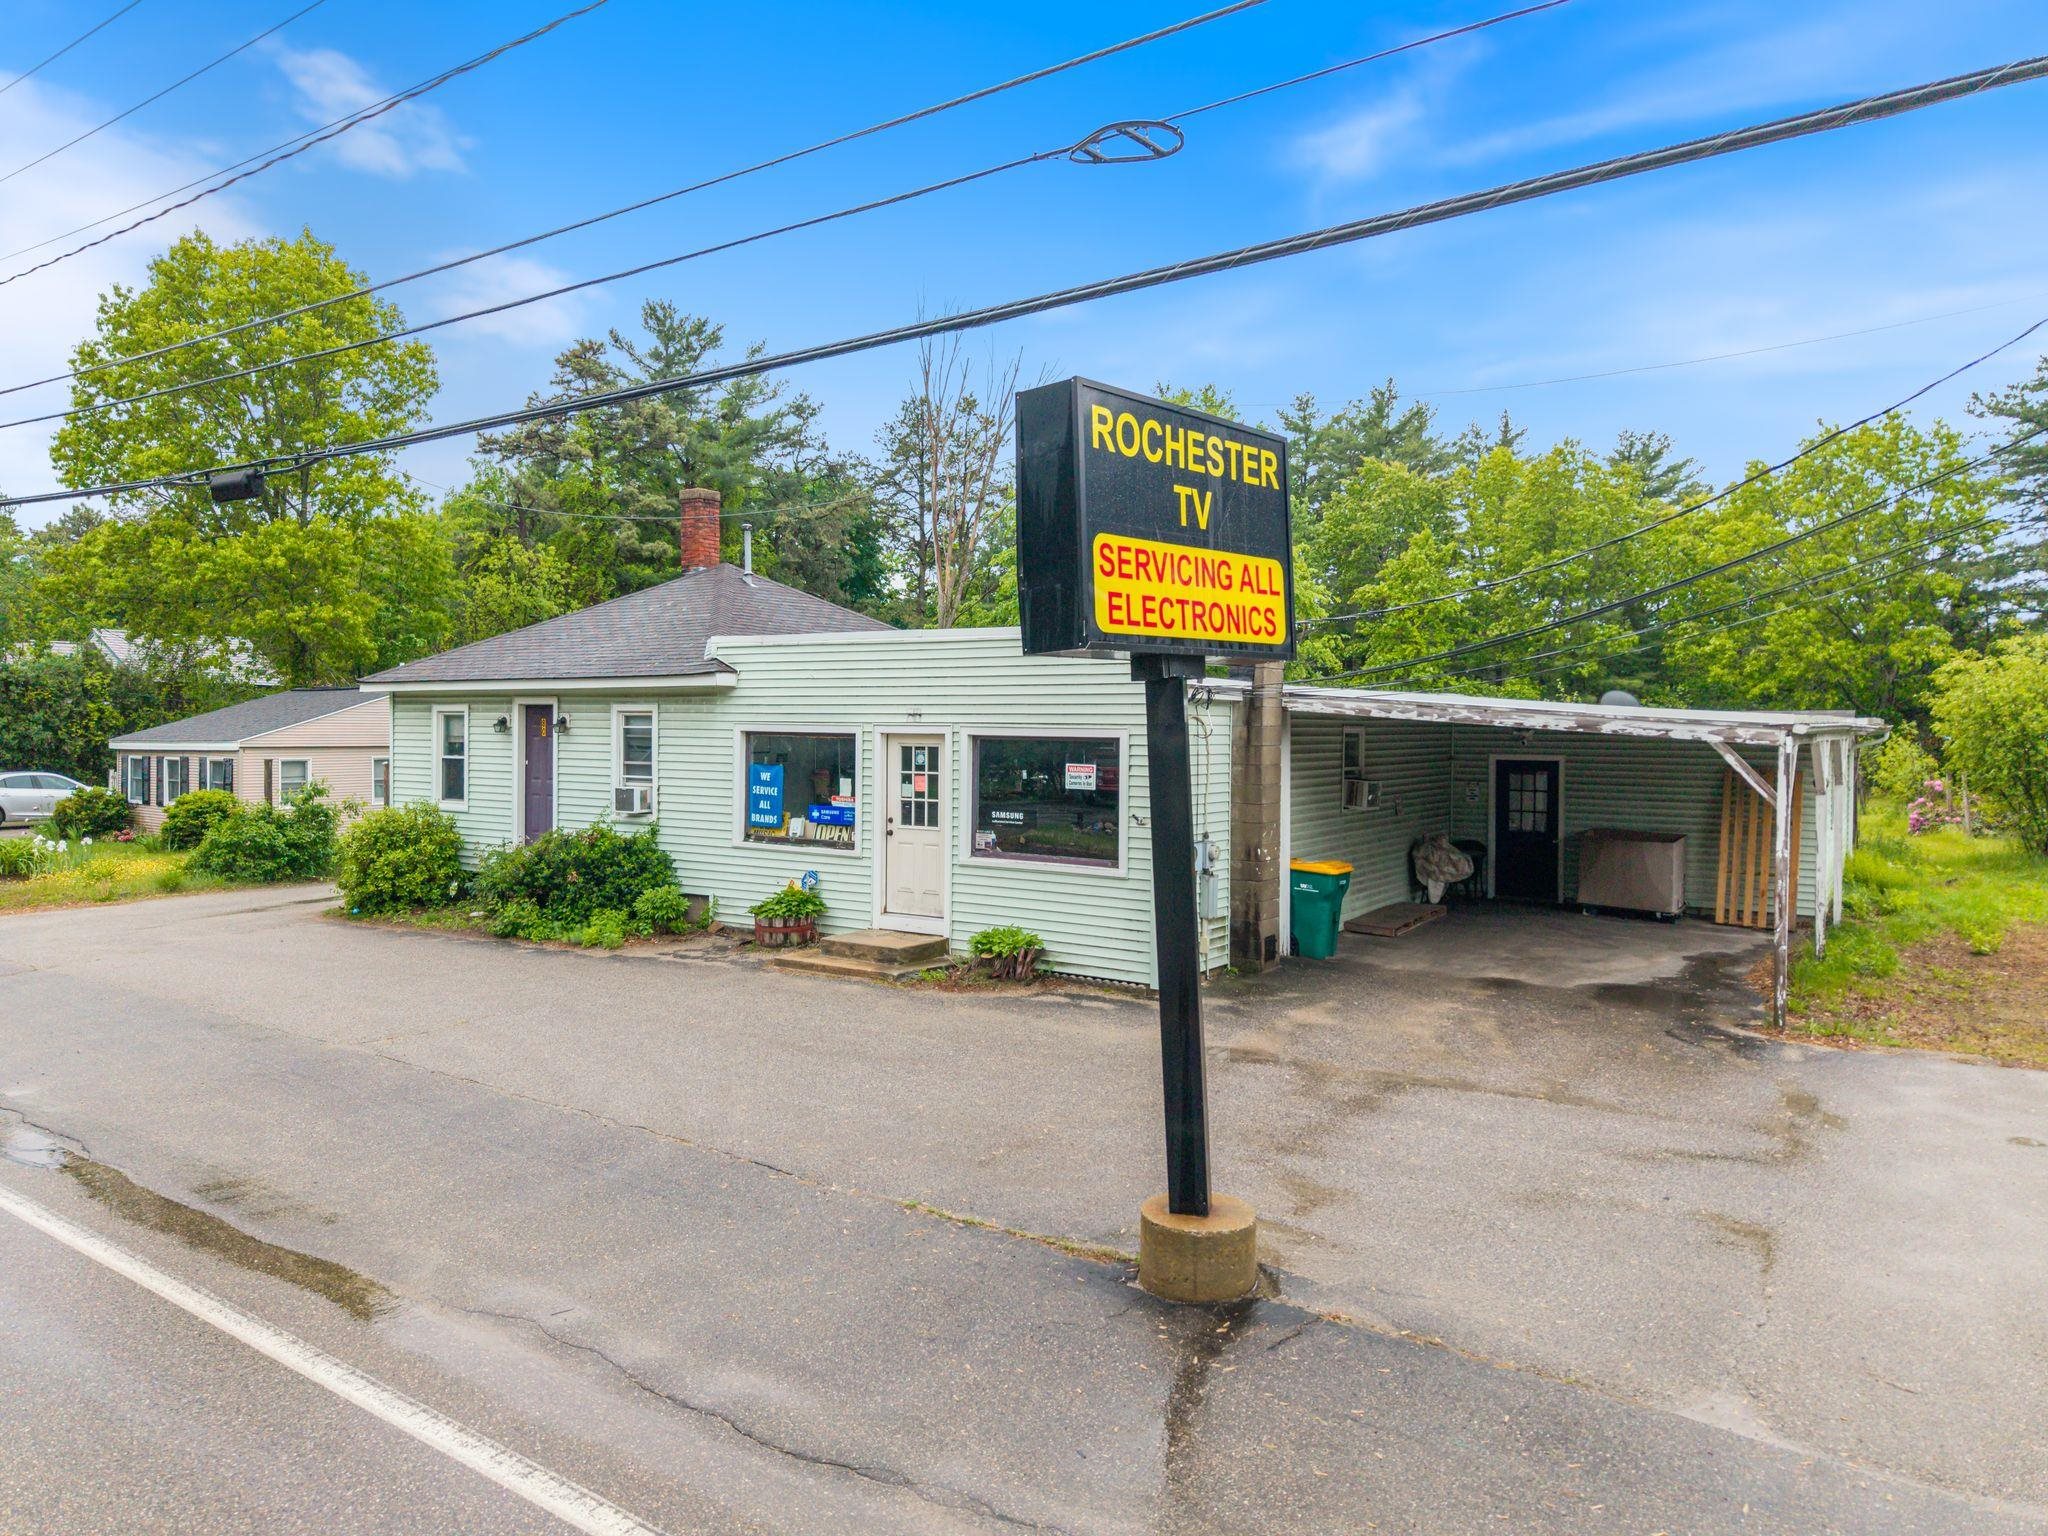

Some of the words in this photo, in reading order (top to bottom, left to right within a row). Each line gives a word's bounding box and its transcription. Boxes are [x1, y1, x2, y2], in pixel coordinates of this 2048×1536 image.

[1091, 404, 1280, 490] ROCHESTER
[1173, 484, 1212, 530] TV
[1099, 543, 1233, 591] SERVICING
[1239, 563, 1281, 596] ALL
[1107, 591, 1277, 638] ELECTRONICS
[760, 772, 771, 781] WE
[752, 785, 778, 796] SERVICE
[759, 800, 771, 809] ALL
[751, 813, 778, 824] BRANDS
[991, 811, 1024, 820] SAMSUNG
[816, 824, 850, 841] OPEN
